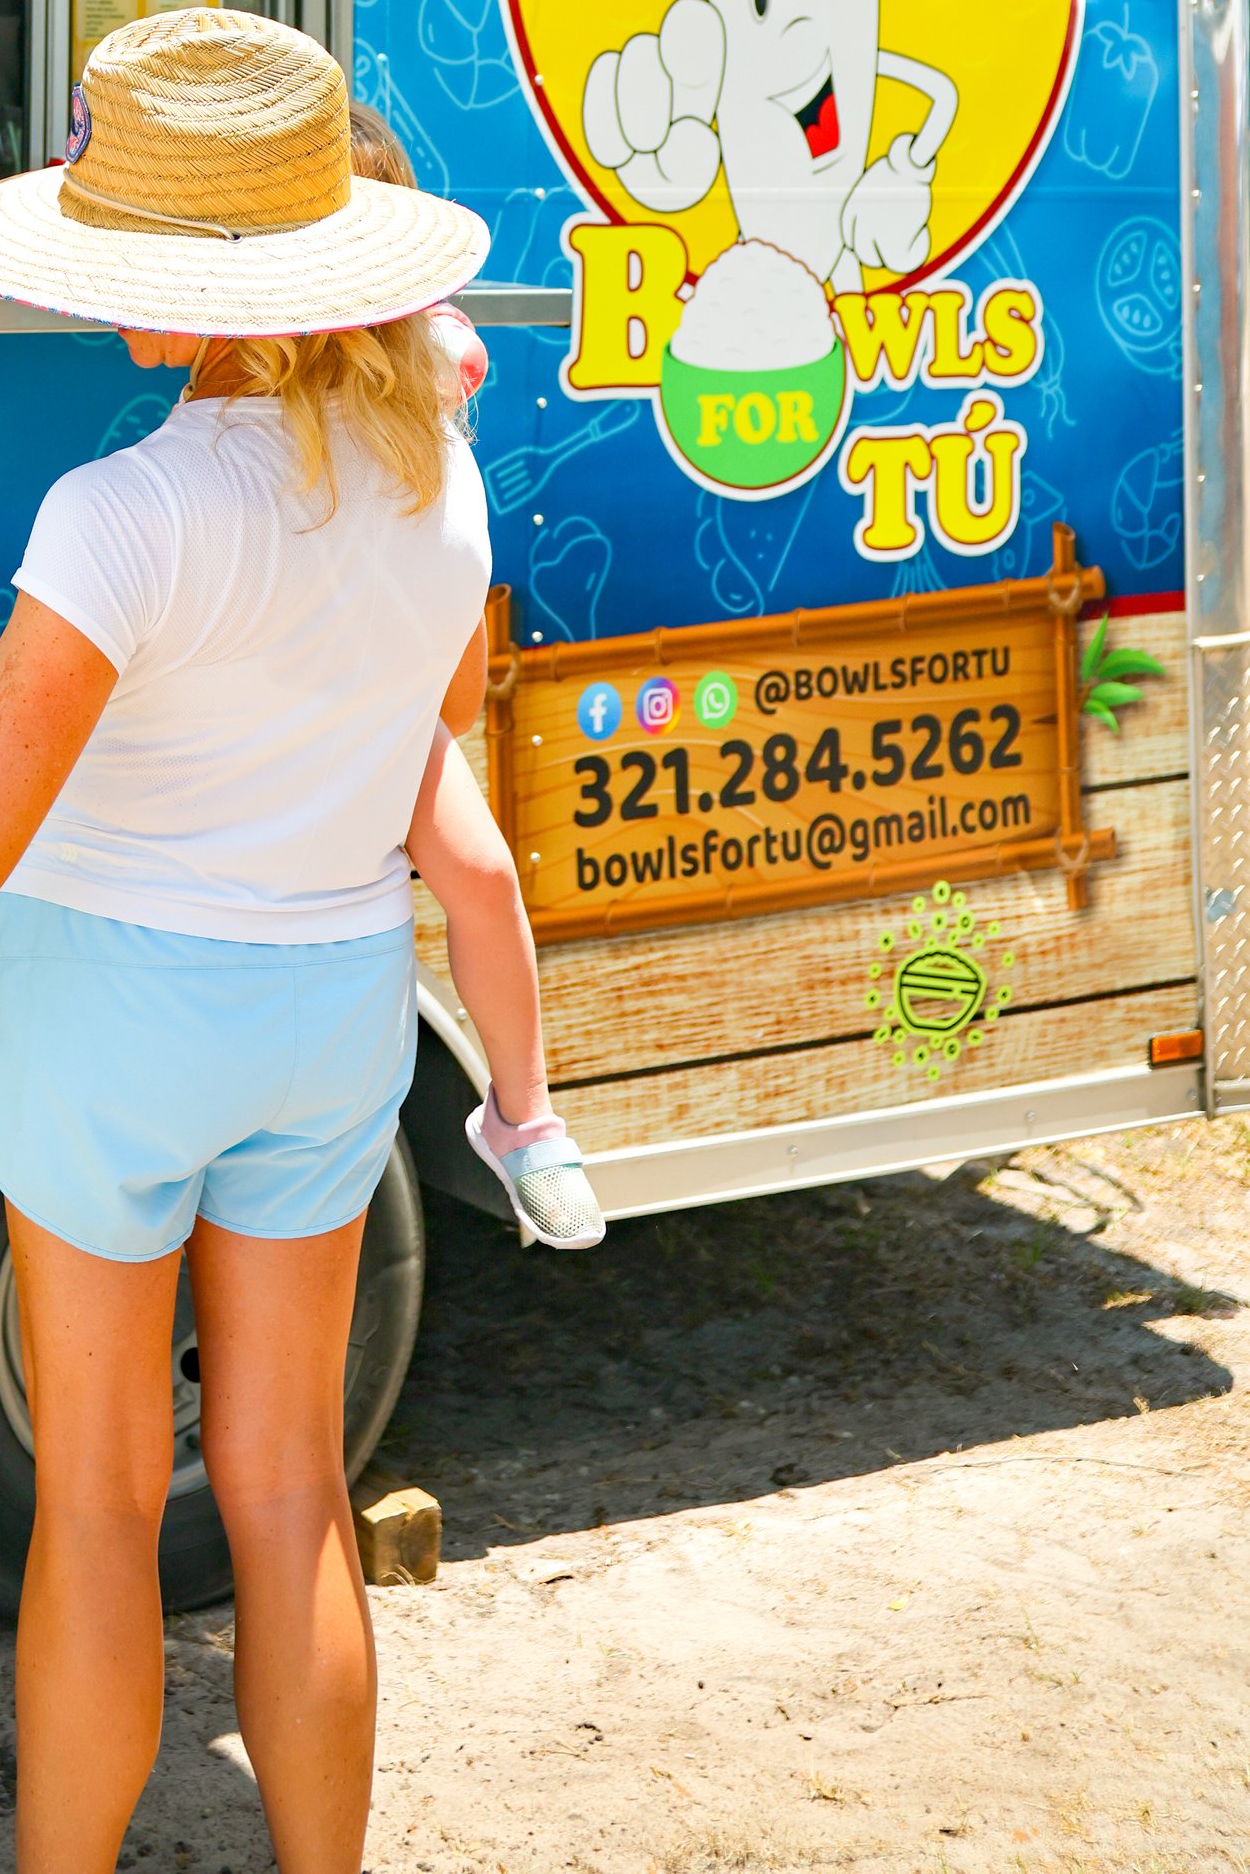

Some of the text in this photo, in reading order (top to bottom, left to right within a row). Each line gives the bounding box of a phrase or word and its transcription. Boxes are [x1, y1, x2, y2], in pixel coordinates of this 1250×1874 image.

[696, 390, 819, 447] FOR
[846, 400, 1020, 550] TÚ
[754, 646, 1012, 715] @BOWLSFORTU
[573, 703, 1022, 828] 321.284.5262
[575, 792, 1032, 891] bowlsfortu@gmail.com
